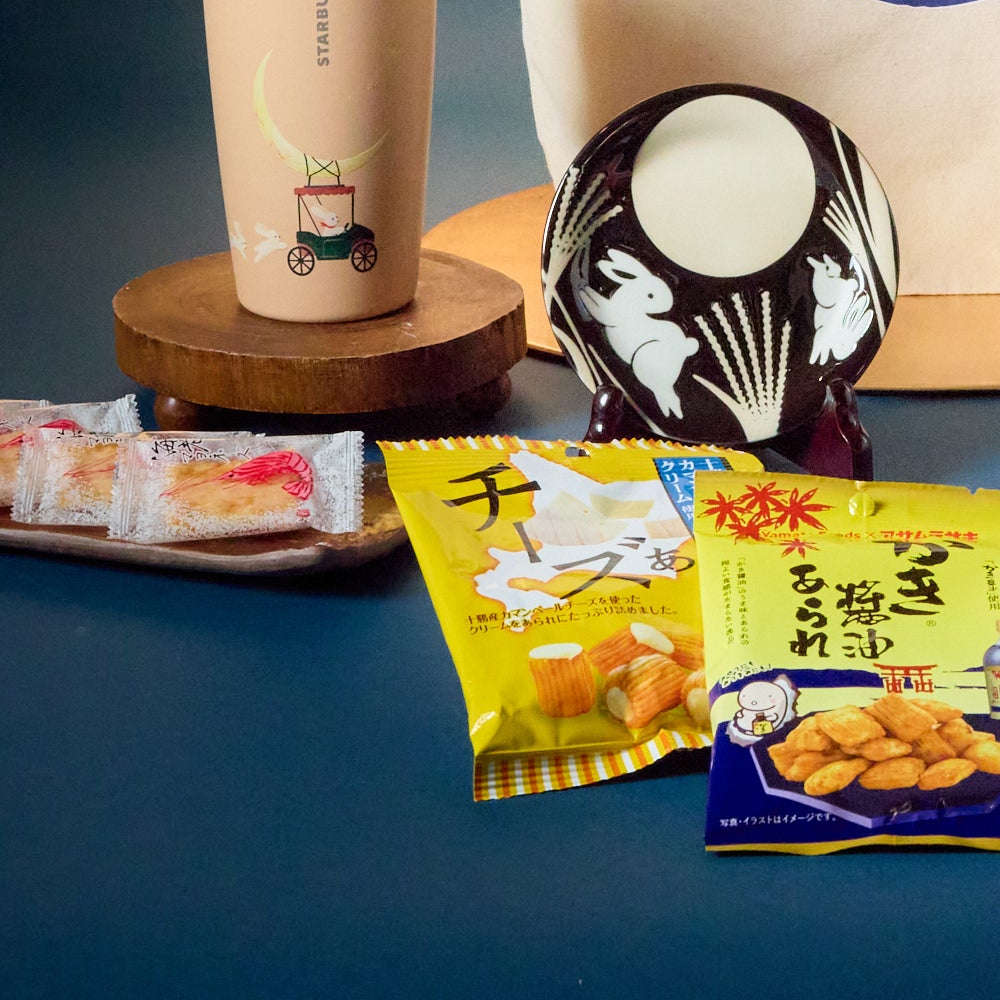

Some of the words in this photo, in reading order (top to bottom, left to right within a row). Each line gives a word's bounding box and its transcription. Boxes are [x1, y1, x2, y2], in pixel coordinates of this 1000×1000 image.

[788, 563, 831, 658] あられ
[873, 540, 974, 615] かき
[719, 812, 837, 828] 写真・イラストはイメージです。
